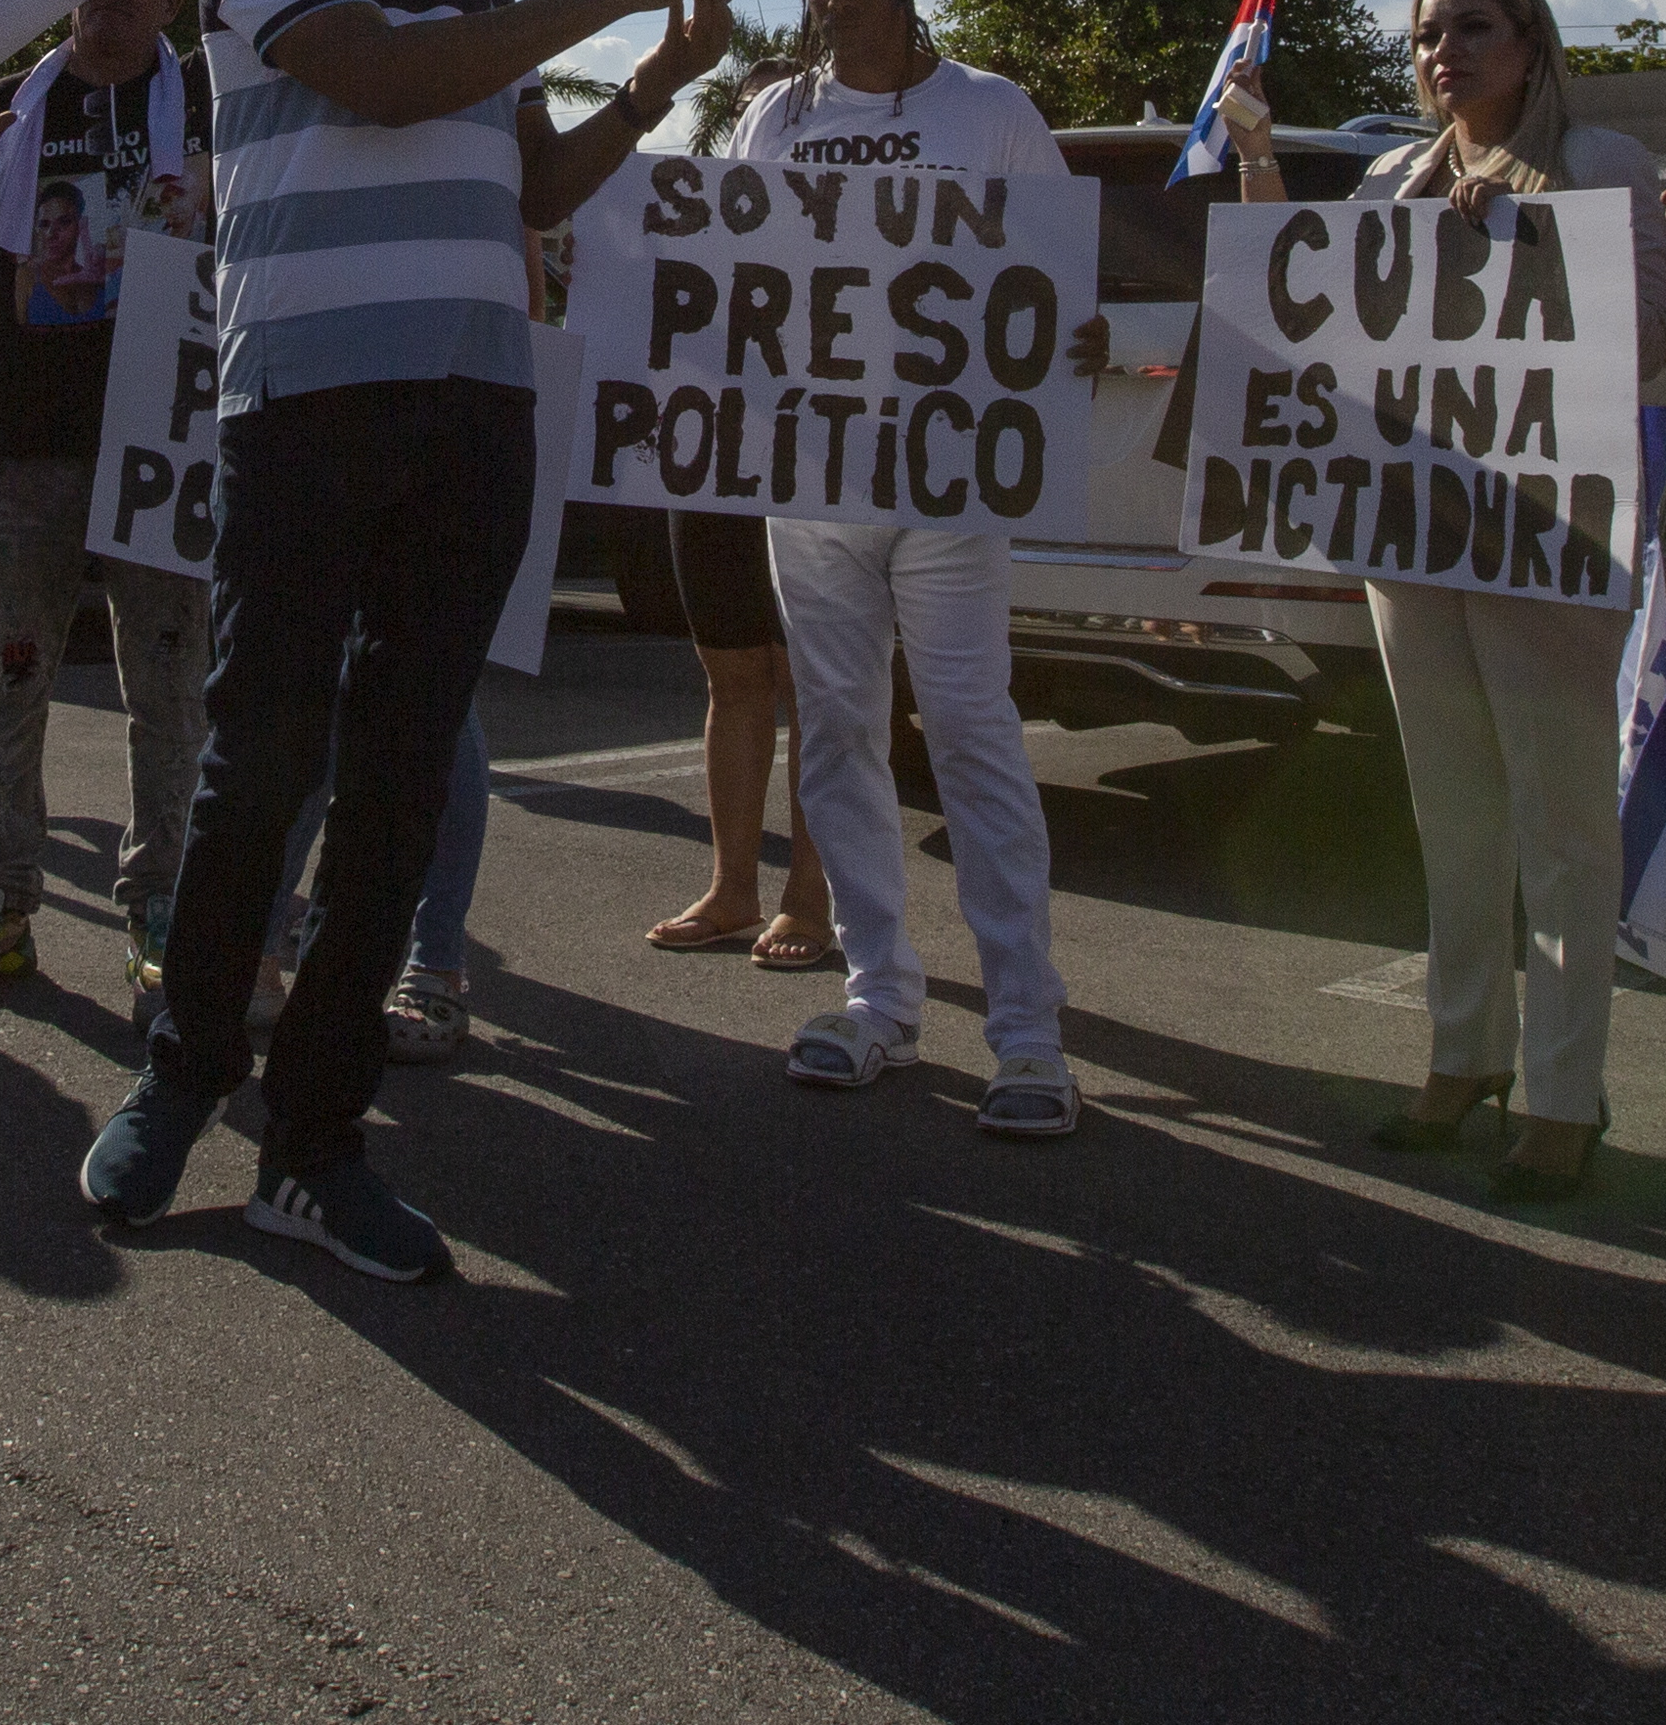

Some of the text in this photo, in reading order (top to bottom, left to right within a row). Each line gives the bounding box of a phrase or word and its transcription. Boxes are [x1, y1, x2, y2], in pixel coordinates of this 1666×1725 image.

[642, 157, 1007, 249] SOY UN
[790, 131, 921, 166] #TODOS
[647, 259, 1058, 392] PRESO
[1267, 203, 1576, 344] CUBA
[1241, 362, 1558, 461] ES UNA
[1198, 455, 1615, 597] DICTADURA
